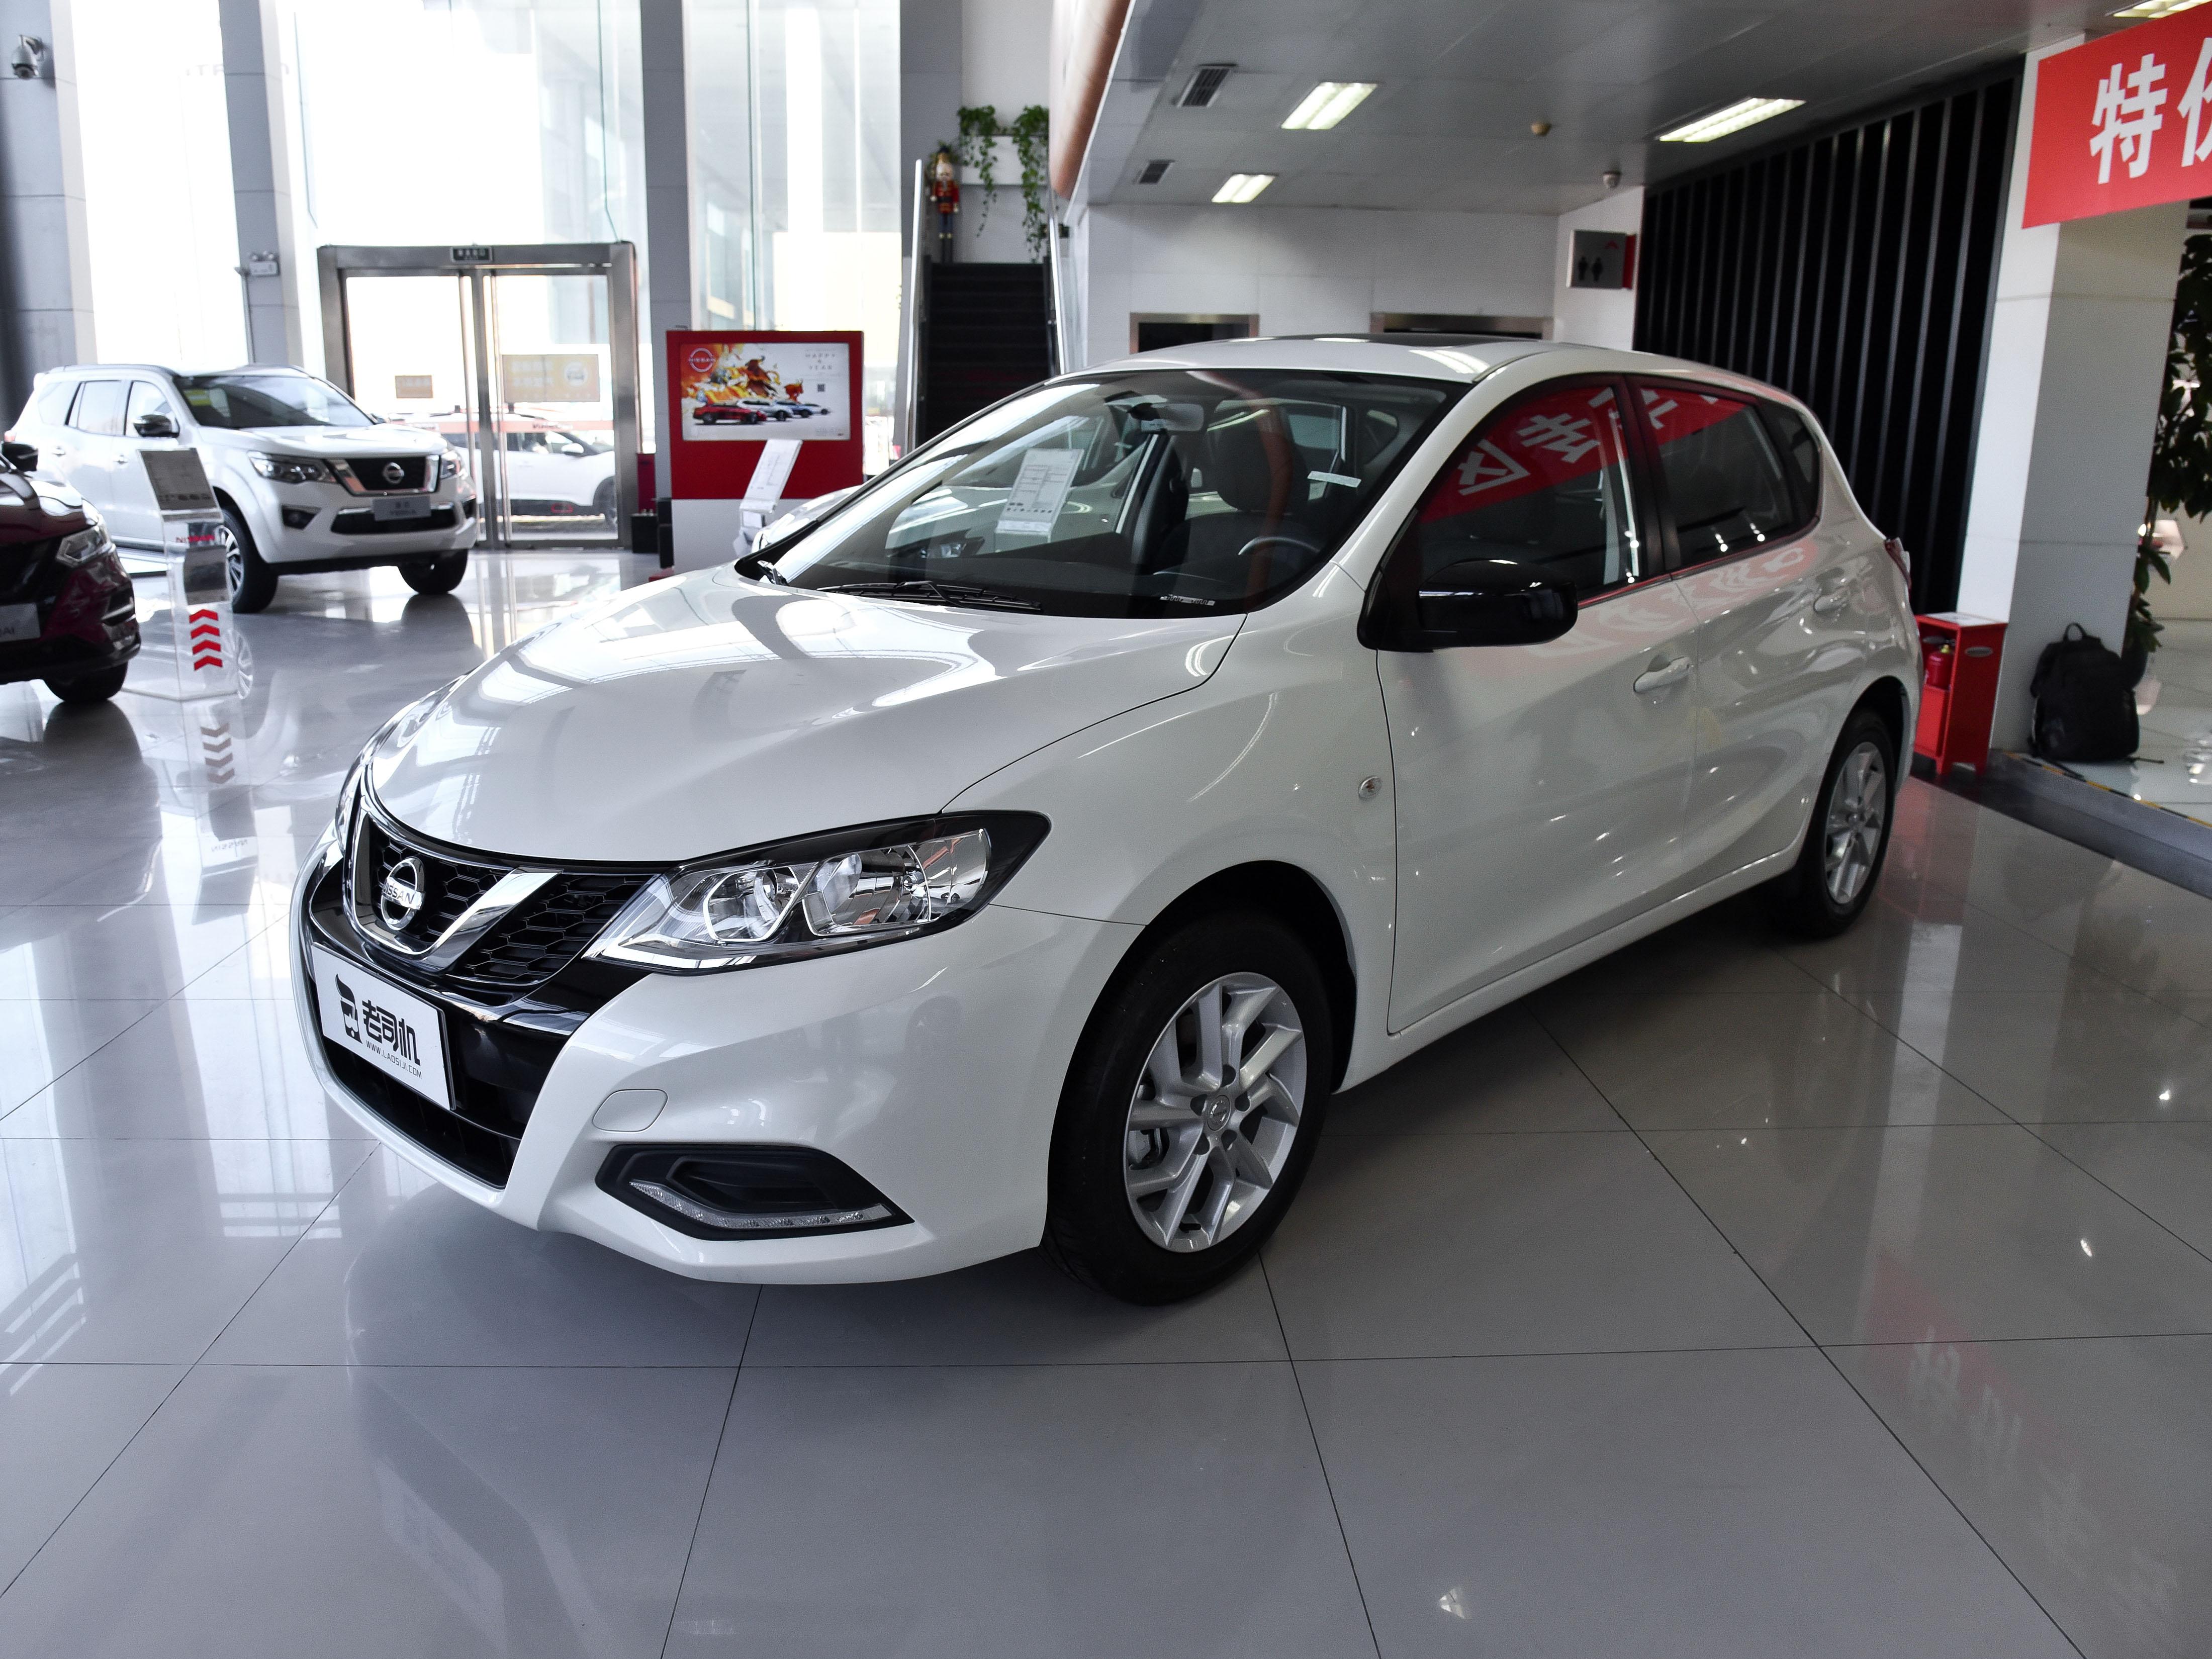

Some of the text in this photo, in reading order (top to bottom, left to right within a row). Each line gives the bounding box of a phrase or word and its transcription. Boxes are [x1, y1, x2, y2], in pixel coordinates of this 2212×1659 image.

[361, 999, 421, 1066] 老司机
[365, 1040, 422, 1079] WWW.LAOSIJI.COM
